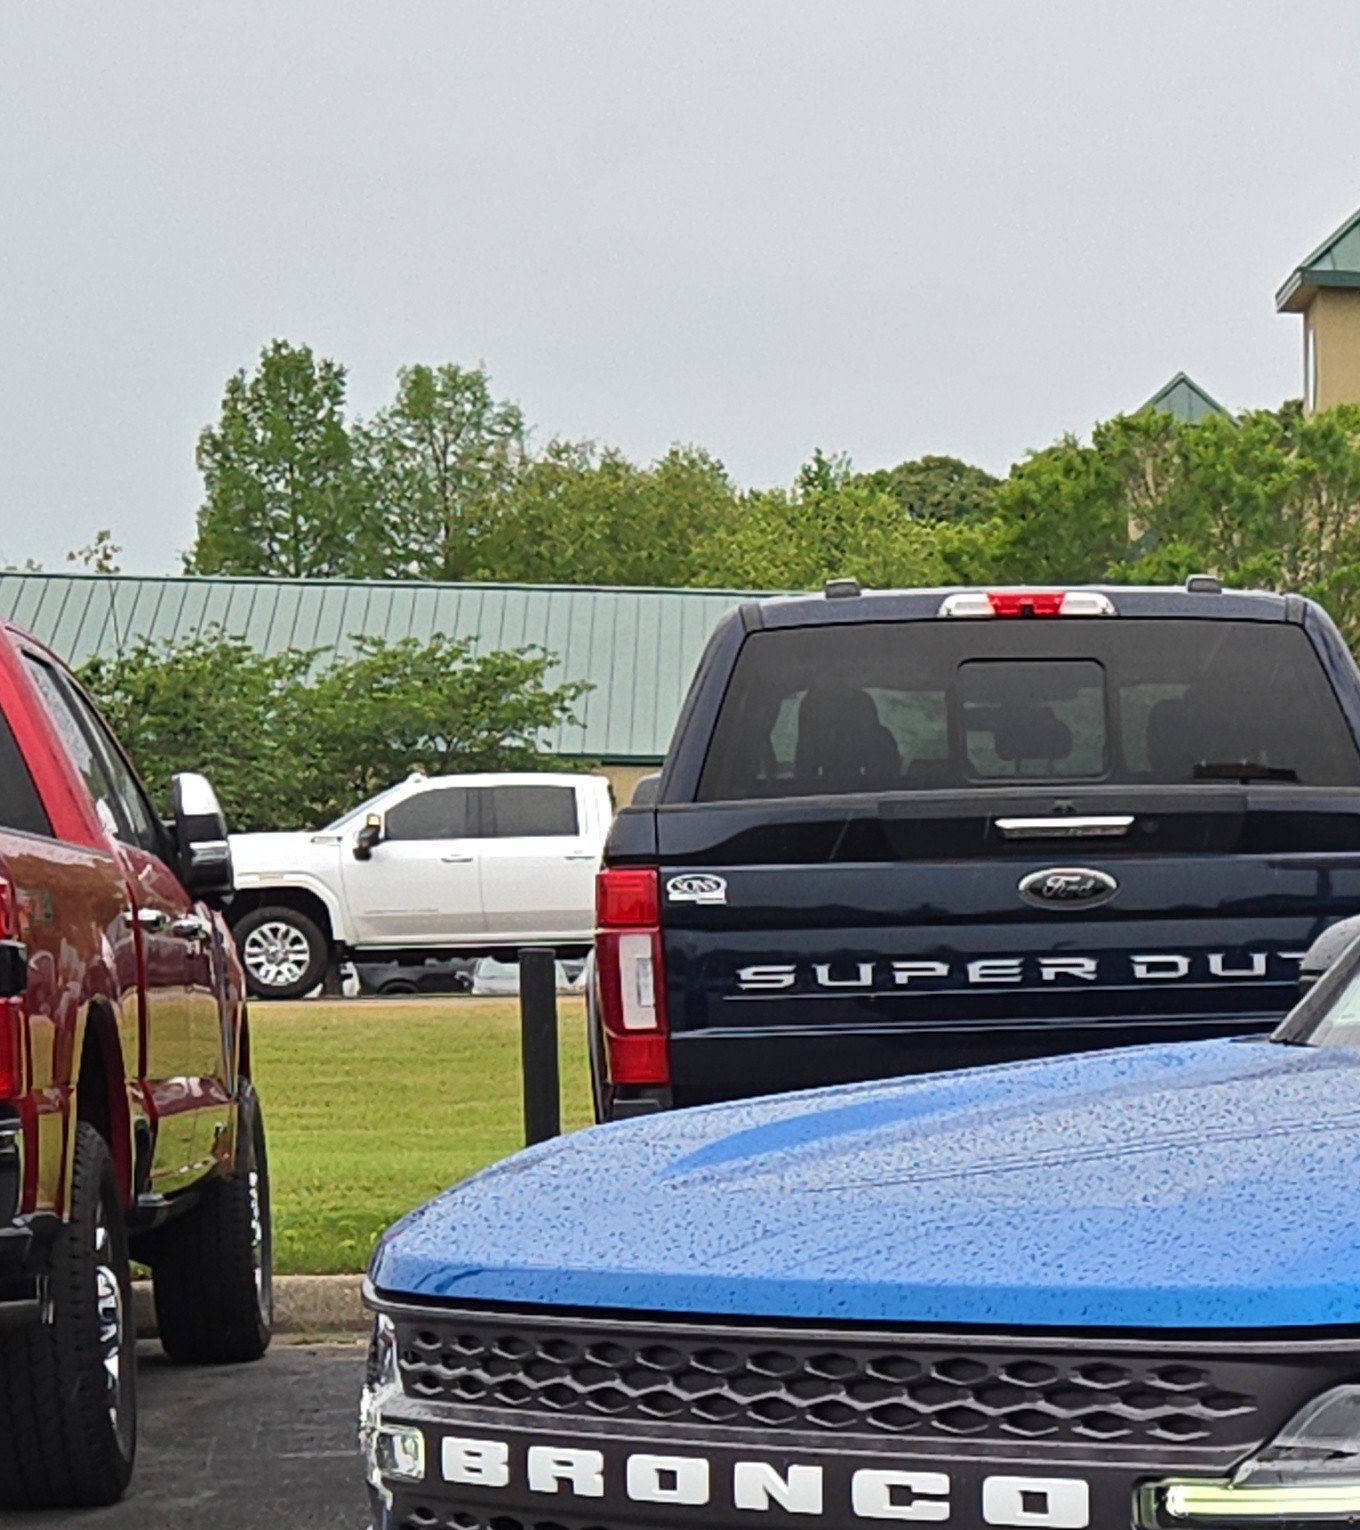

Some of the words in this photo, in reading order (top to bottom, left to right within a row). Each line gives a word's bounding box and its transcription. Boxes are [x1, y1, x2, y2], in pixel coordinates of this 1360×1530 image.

[1041, 875, 1096, 898] Ford
[736, 956, 1099, 990] SUPER
[440, 1436, 1090, 1529] BRONCO
